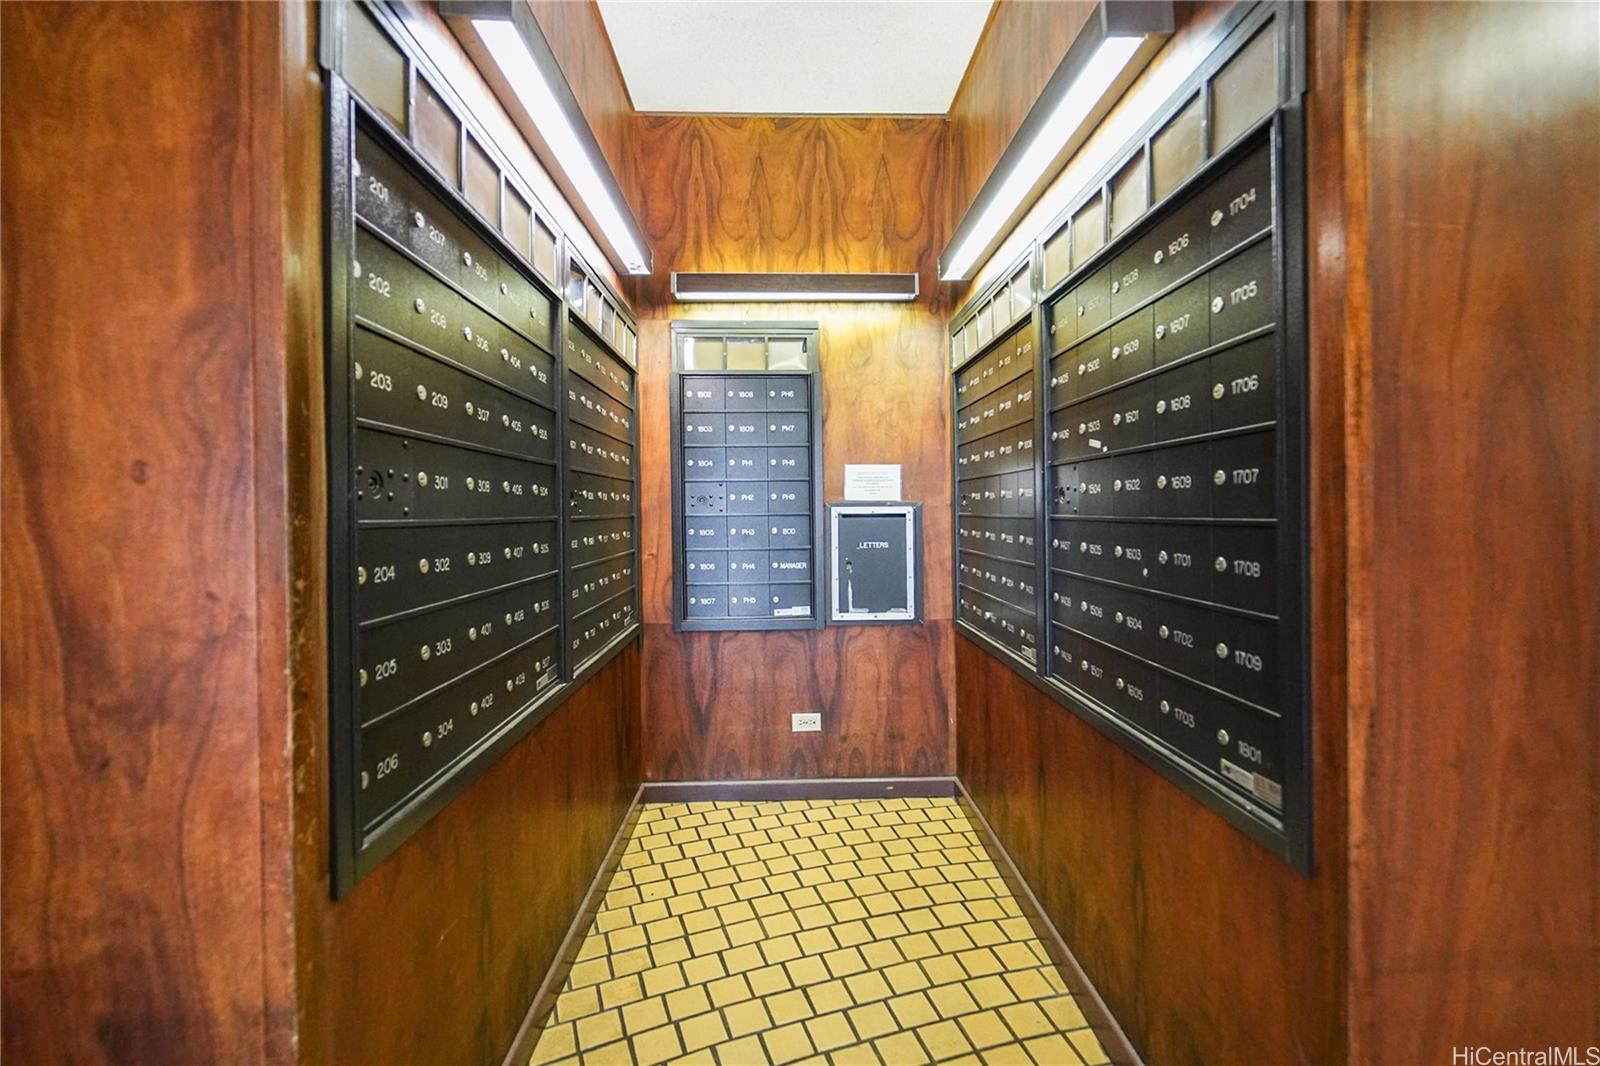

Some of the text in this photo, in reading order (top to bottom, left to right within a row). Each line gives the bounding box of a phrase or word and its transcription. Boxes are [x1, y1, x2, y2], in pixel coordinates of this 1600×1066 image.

[369, 176, 389, 203] 201
[1229, 189, 1257, 215] 1704
[429, 226, 446, 246] 207
[1168, 233, 1189, 256] 1606
[368, 271, 391, 298] 202
[1231, 280, 1257, 305] 1705
[1170, 314, 1190, 334] 1607
[1123, 339, 1140, 354] 1509
[370, 372, 392, 391] 203
[1232, 375, 1259, 395] 1706
[432, 392, 448, 409] 209
[1171, 395, 1191, 412] 1608
[477, 407, 490, 422] 307
[1125, 410, 1139, 424] 1601
[435, 475, 449, 490] 301
[477, 479, 490, 492] 308
[1125, 480, 1141, 490] 1602
[1172, 476, 1192, 488] 1609
[1233, 469, 1259, 484] 1707
[478, 552, 491, 565] 309
[513, 546, 524, 558] 407
[1126, 548, 1142, 561] 1603
[1174, 553, 1191, 566] 1701
[374, 564, 396, 584] 204
[435, 558, 450, 573] 302
[1234, 560, 1262, 578] 1708
[480, 623, 492, 636] 401
[1126, 616, 1142, 630] 1604
[435, 638, 452, 657] 303
[1174, 630, 1193, 648] 1702
[375, 659, 397, 680] 205
[1234, 649, 1262, 672] 1709
[481, 694, 493, 710] 402
[1174, 708, 1195, 727] 1703
[437, 718, 454, 740] 304
[1238, 740, 1262, 764] 1801
[376, 753, 400, 780] 206
